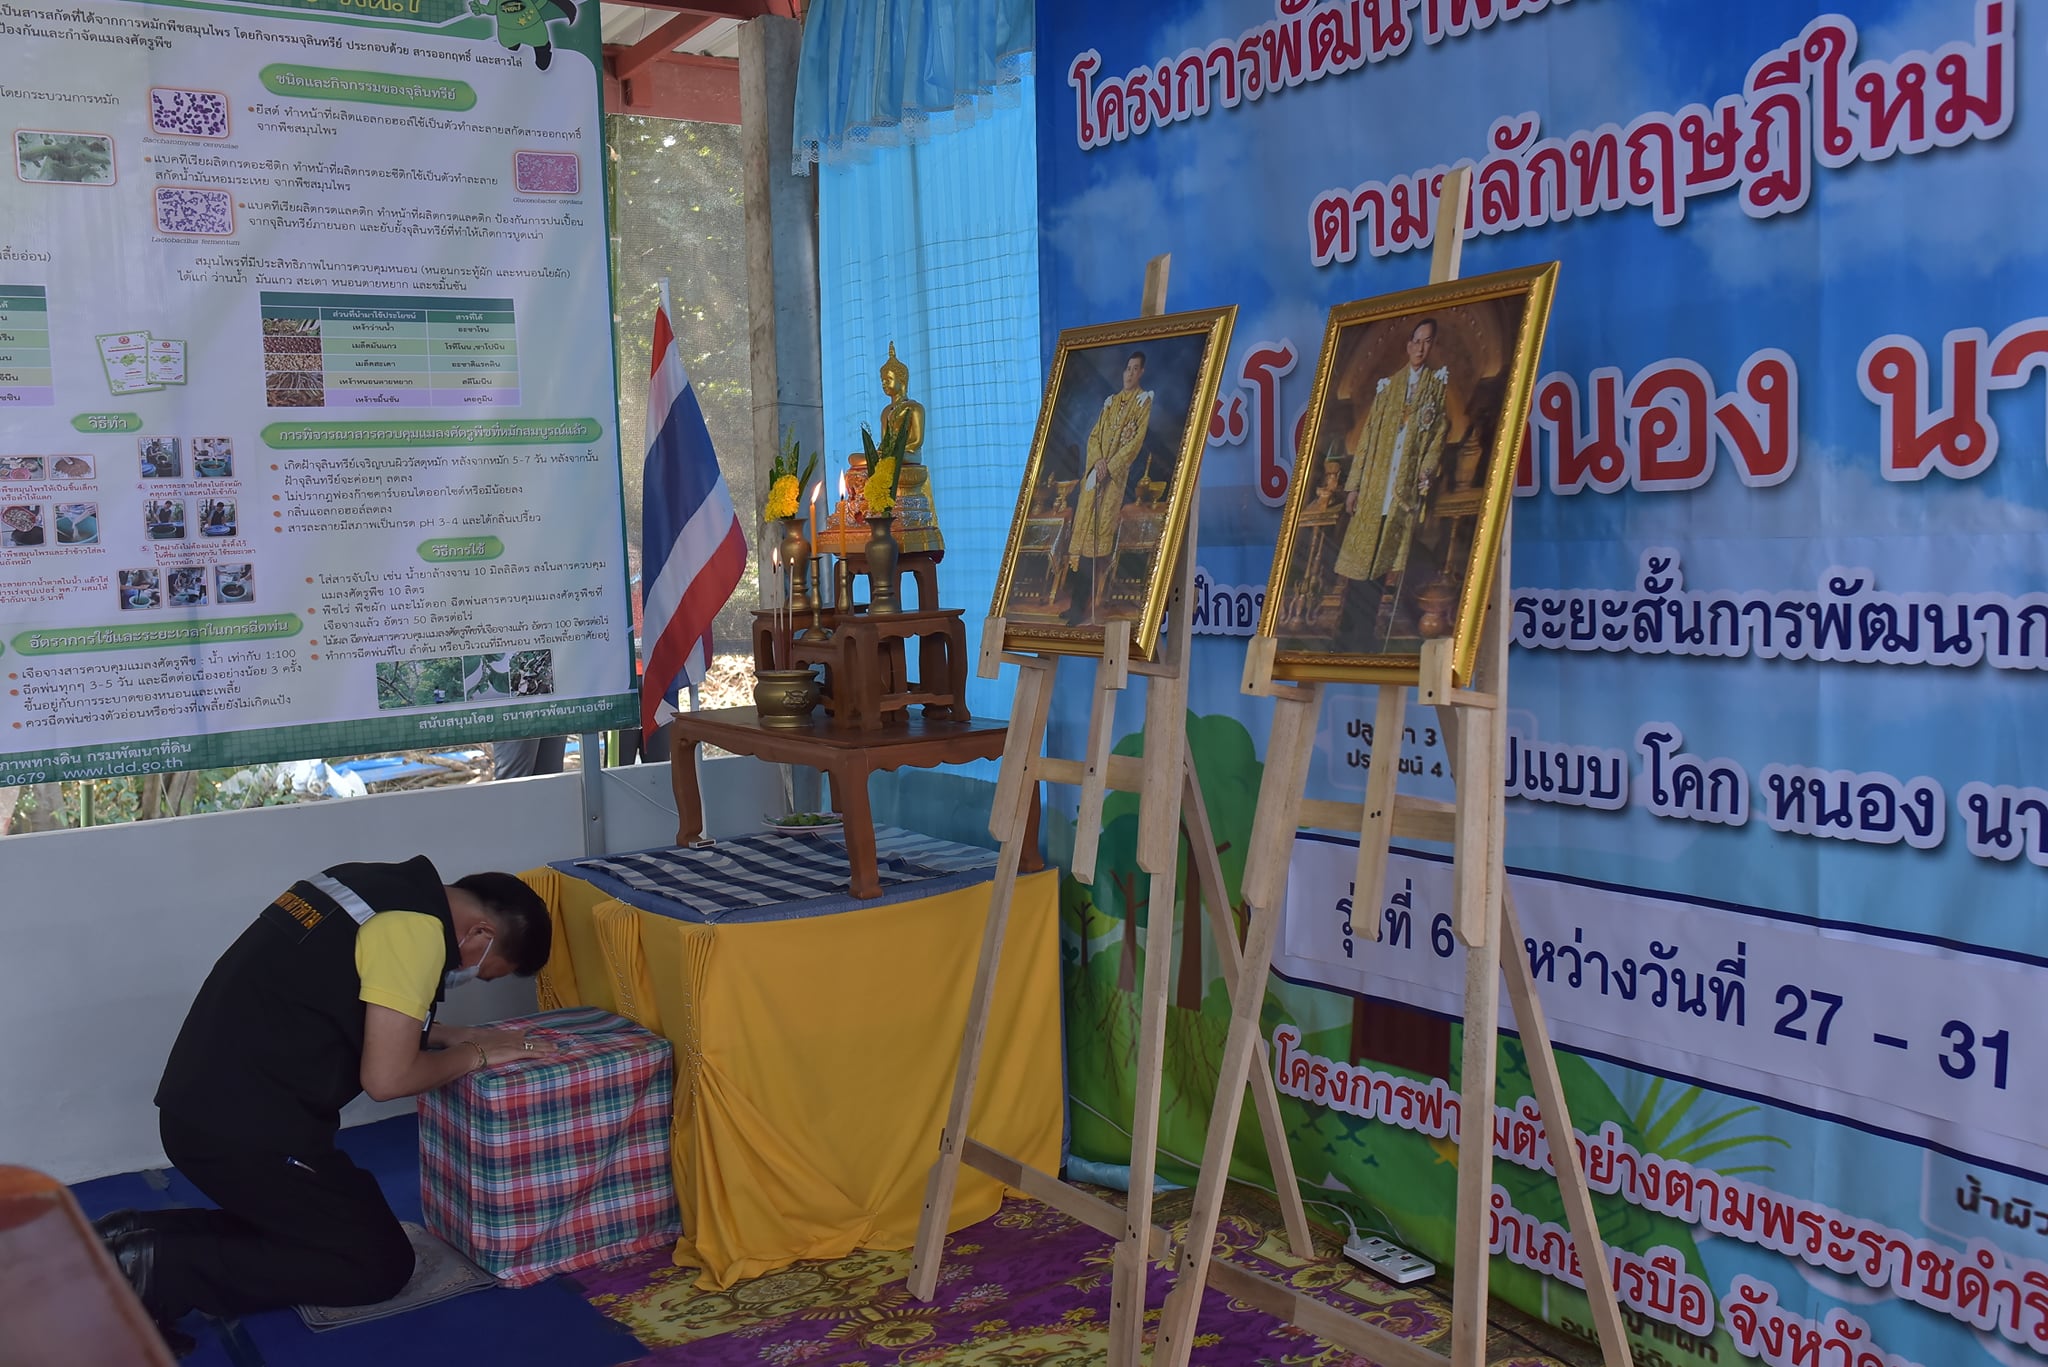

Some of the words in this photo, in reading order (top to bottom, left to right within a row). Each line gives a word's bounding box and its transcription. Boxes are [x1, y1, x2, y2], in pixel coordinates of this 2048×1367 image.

[346, 40, 409, 56] ประกอบด้วย
[413, 45, 471, 62] สารออกฤทธิ์
[475, 53, 523, 68] และสารไล่
[88, 416, 128, 431] วิธีทำ
[513, 455, 531, 466] 5-7
[535, 453, 548, 465] วัน
[419, 518, 434, 530] pH
[438, 516, 458, 527] 3-4
[474, 567, 487, 577] 10
[389, 586, 402, 597] 10
[414, 613, 427, 625] 50
[555, 618, 572, 630] 100
[266, 648, 296, 660] 1:100
[90, 679, 112, 690] 3-5
[117, 674, 133, 688] วัน
[271, 664, 279, 675] 3
[63, 757, 183, 780] www.ldd.go.th
[1643, 731, 1740, 816] โคก
[1768, 773, 1934, 838] หนอง
[1431, 912, 1455, 958] 6
[1774, 984, 1844, 1046] 27
[1938, 1019, 2010, 1091] 31
